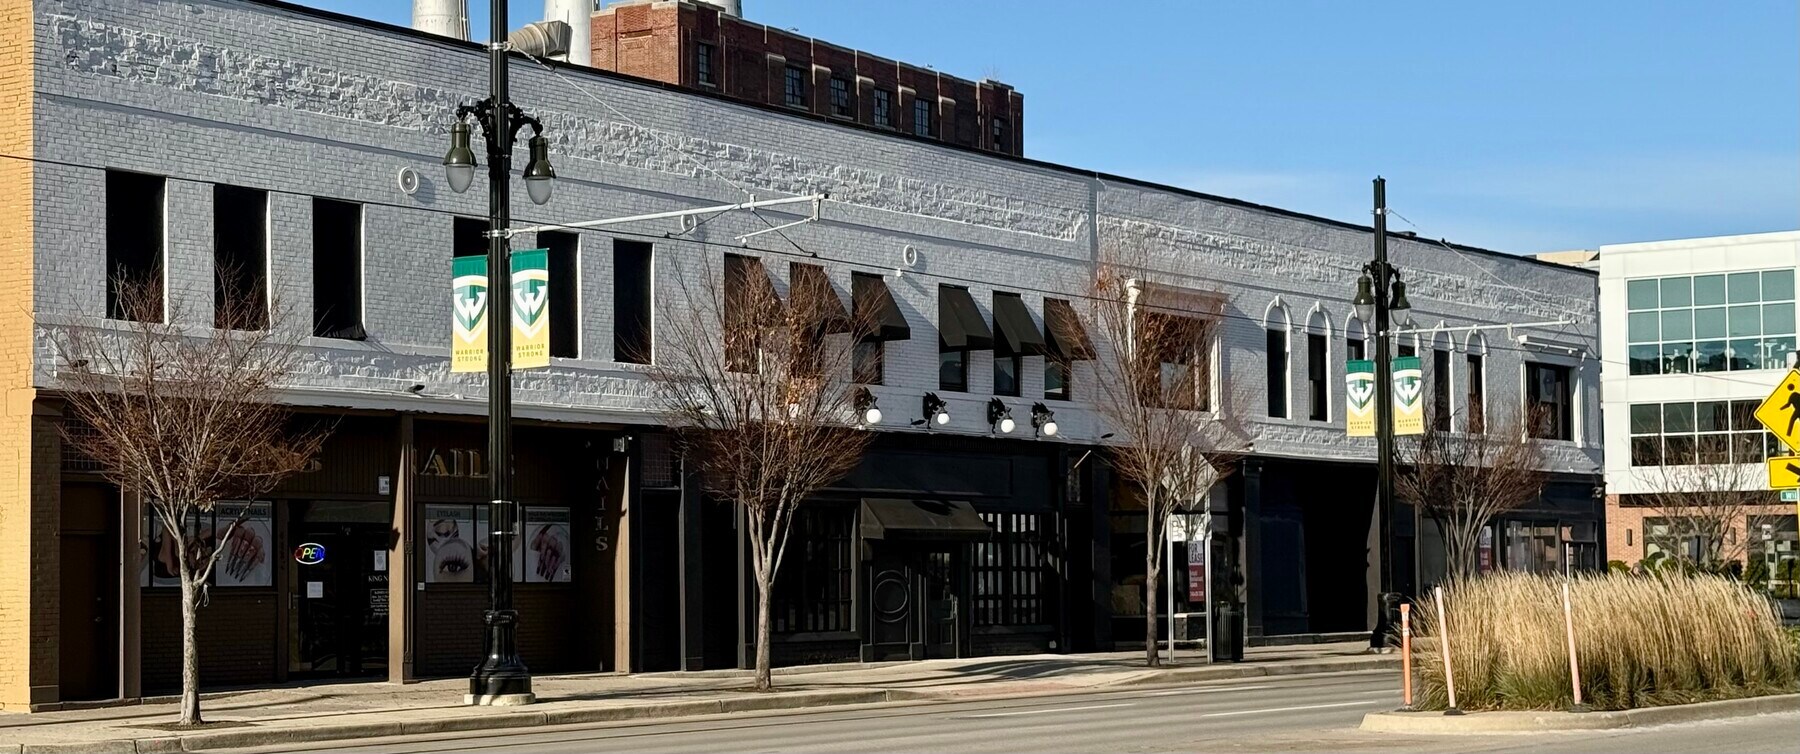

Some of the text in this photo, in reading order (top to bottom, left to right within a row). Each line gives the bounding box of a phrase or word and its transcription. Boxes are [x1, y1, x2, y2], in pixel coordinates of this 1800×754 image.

[518, 350, 543, 358] STRONG
[594, 456, 610, 552] NAILS
[220, 507, 245, 516] ACRYL
[246, 507, 267, 516] NAILS
[436, 510, 461, 518] EYELASH
[1188, 542, 1198, 553] FOR
[294, 547, 326, 560] OPEN
[1188, 552, 1204, 564] LEASE
[368, 575, 383, 583] KING
